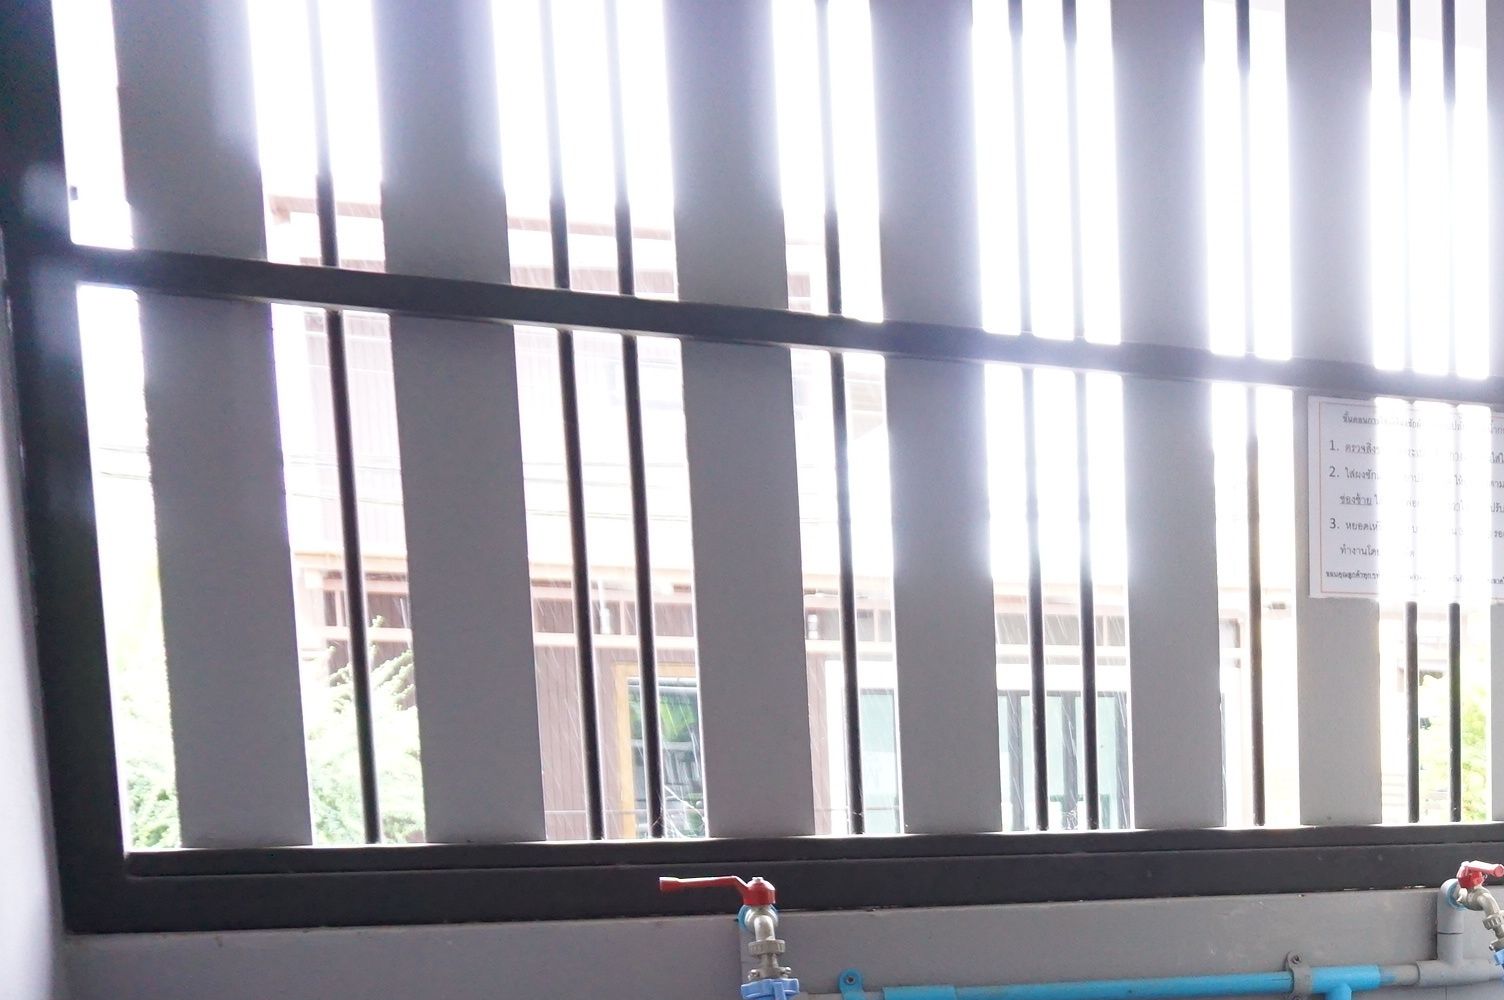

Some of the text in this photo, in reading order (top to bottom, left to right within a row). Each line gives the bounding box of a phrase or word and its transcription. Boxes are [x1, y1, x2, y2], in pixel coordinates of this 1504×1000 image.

[1329, 439, 1340, 452] 1.
[1329, 465, 1340, 478] 2.
[1329, 517, 1340, 530] 3.
